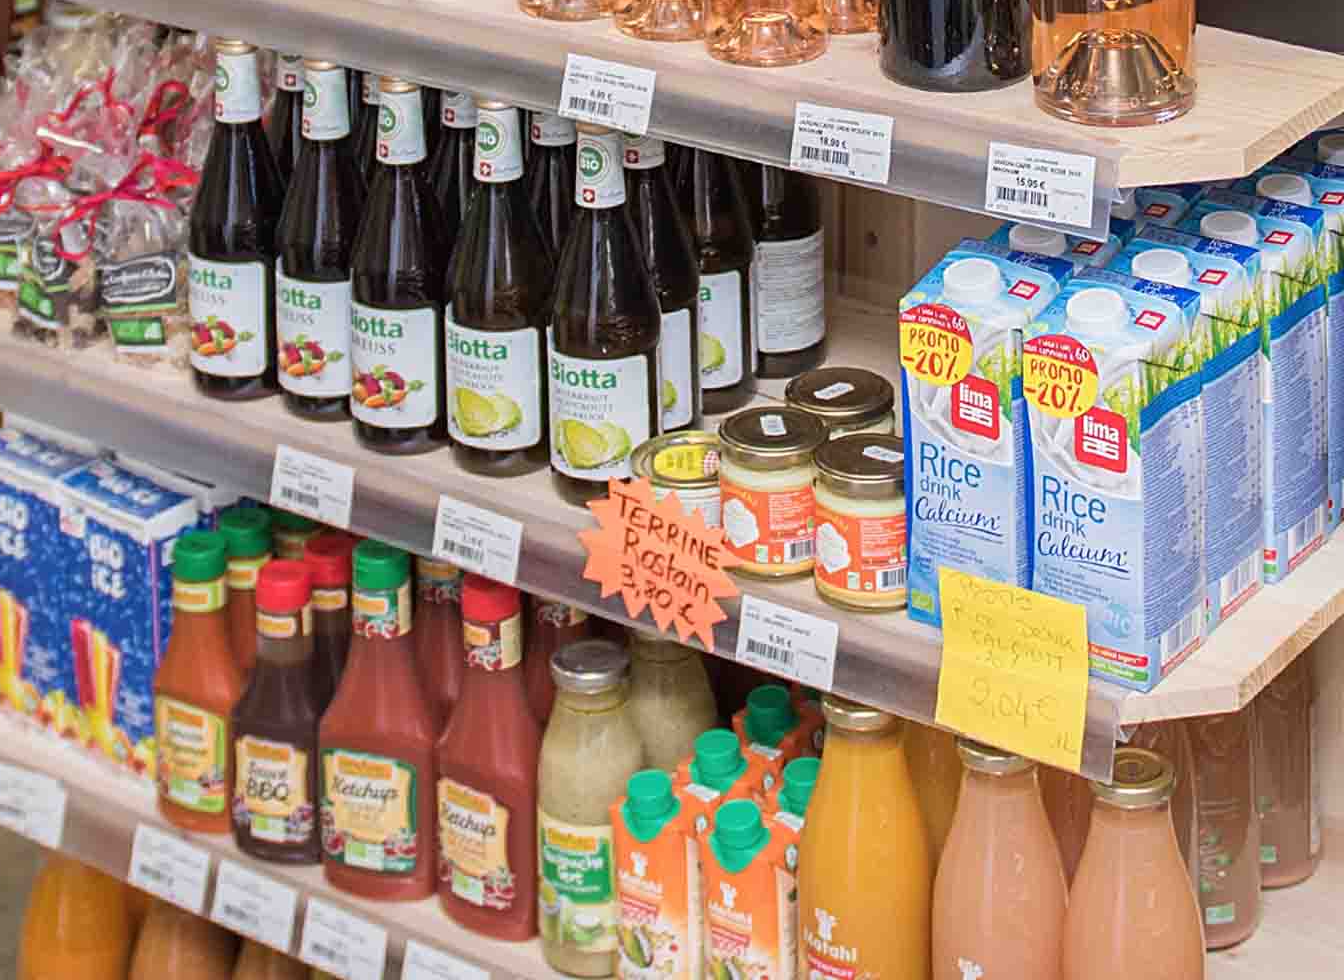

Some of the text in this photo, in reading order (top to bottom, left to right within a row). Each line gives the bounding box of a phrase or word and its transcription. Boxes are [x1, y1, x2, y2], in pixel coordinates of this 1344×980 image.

[191, 267, 233, 290] otta
[278, 284, 322, 310] otta
[351, 312, 403, 339] iotta
[909, 328, 960, 353] PROMO
[550, 356, 617, 390] Biotta
[903, 349, 960, 381] -20%
[1030, 358, 1083, 386] PROMO
[959, 383, 993, 411] lima
[1023, 381, 1083, 414] -20%
[1082, 414, 1120, 443] lima
[919, 442, 982, 488] Rice
[920, 475, 962, 501] drink
[1041, 475, 1107, 524] Rice
[915, 497, 1001, 531] Calcium
[1042, 511, 1087, 538] drink
[613, 491, 720, 570] TERRINE
[1037, 531, 1129, 566] Calcium
[246, 780, 289, 802] BBQ
[331, 774, 400, 804] Ketchup
[440, 800, 497, 838] Ketchup
